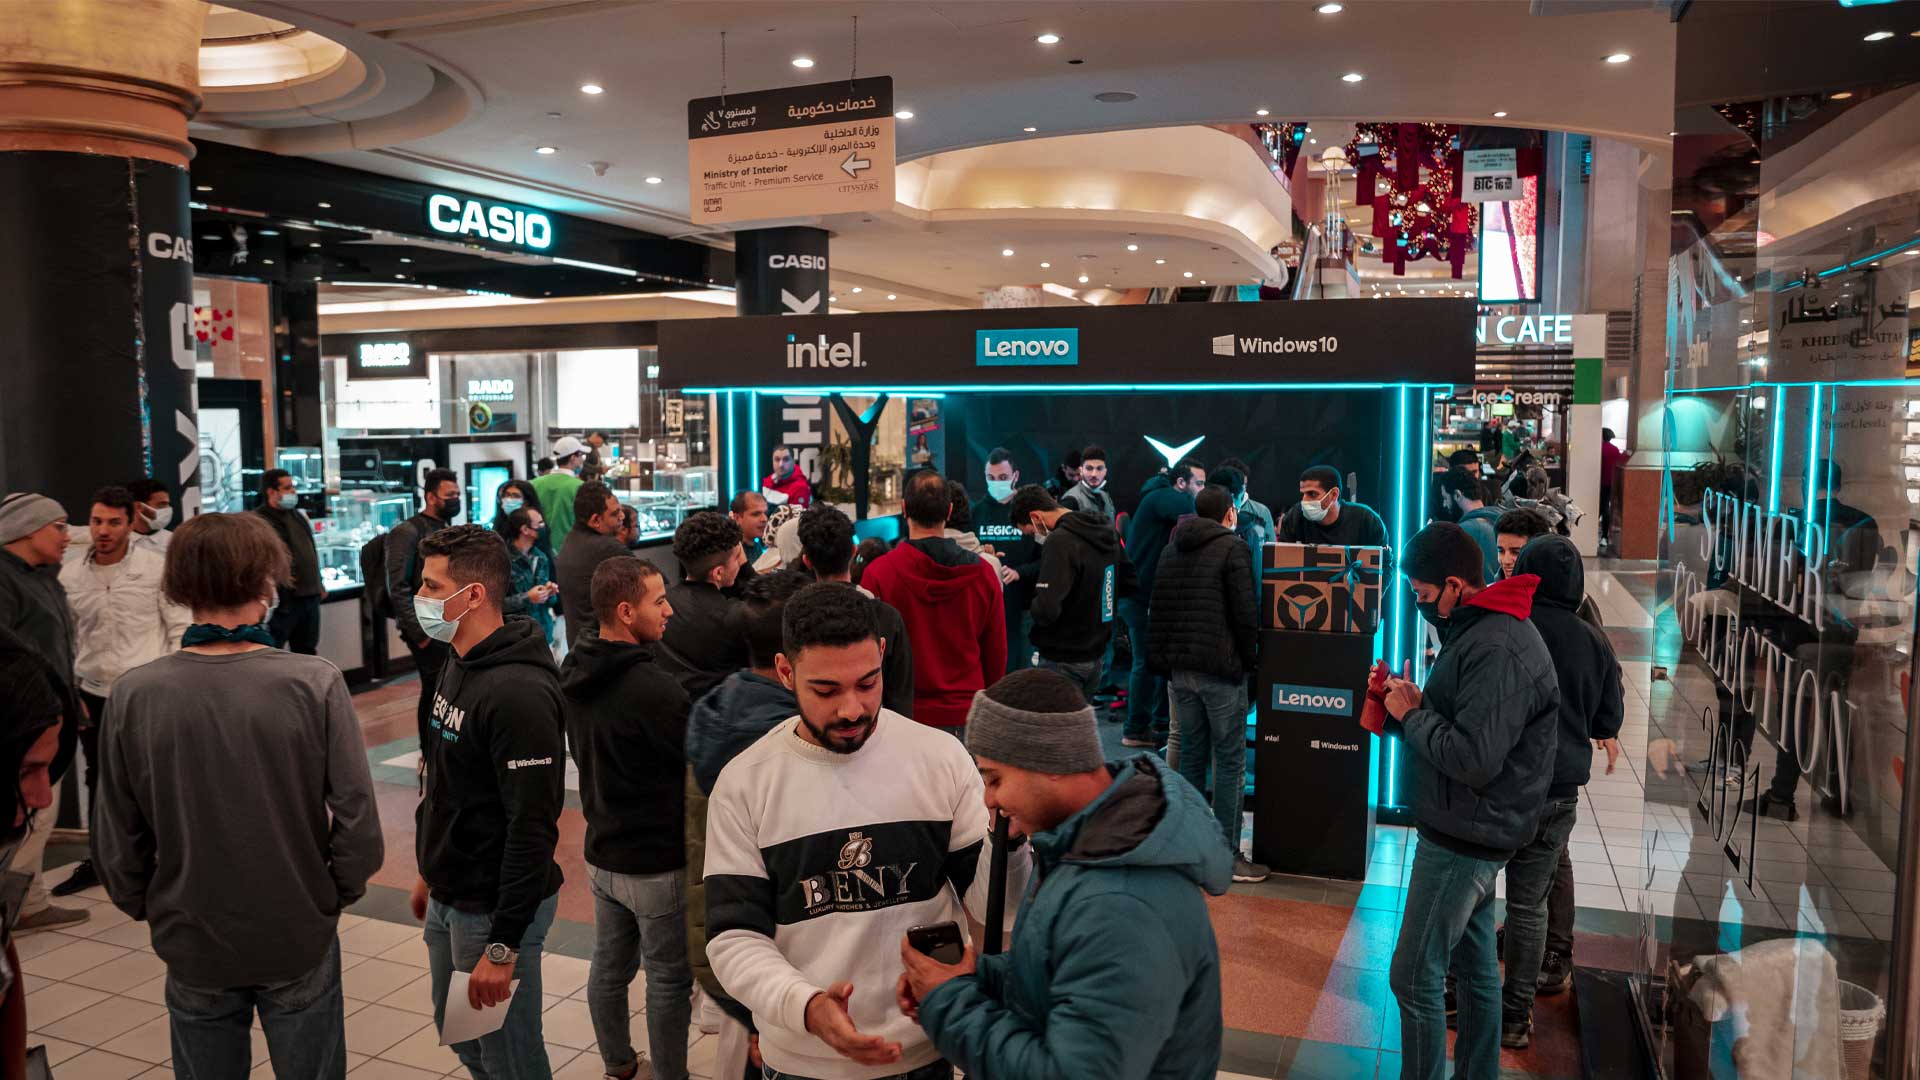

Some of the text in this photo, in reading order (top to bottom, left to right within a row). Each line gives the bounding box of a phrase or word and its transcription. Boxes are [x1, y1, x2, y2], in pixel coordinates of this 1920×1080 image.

[724, 106, 756, 119] المستوى
[788, 96, 876, 119] خدمات حكومية
[727, 117, 756, 129] Level 7
[824, 126, 880, 140] وزارة الداخلية
[828, 142, 852, 154] المرور
[853, 140, 876, 150] وحدة
[754, 151, 778, 160] خدمة
[703, 164, 788, 180] Ministry of Interior
[703, 181, 728, 191] Traffic
[729, 180, 747, 188] Unit
[754, 176, 791, 186] Premium
[793, 173, 824, 183] Service
[429, 194, 552, 249] CASIO
[768, 254, 826, 270] CASIO
[1496, 315, 1572, 343] CAFE
[984, 337, 1069, 357] Lenovo
[468, 379, 514, 394] RADO
[1472, 389, 1561, 405] Ice Cream
[979, 525, 1023, 536] LEGION
[1700, 486, 1826, 632] SUMMER
[1105, 570, 1114, 618] Lenovo
[1673, 560, 1859, 816] COLLECTION
[1278, 689, 1346, 710] Lenovo
[1264, 734, 1280, 742] intel
[1697, 706, 1761, 897] 2021
[799, 862, 918, 909] BENY
